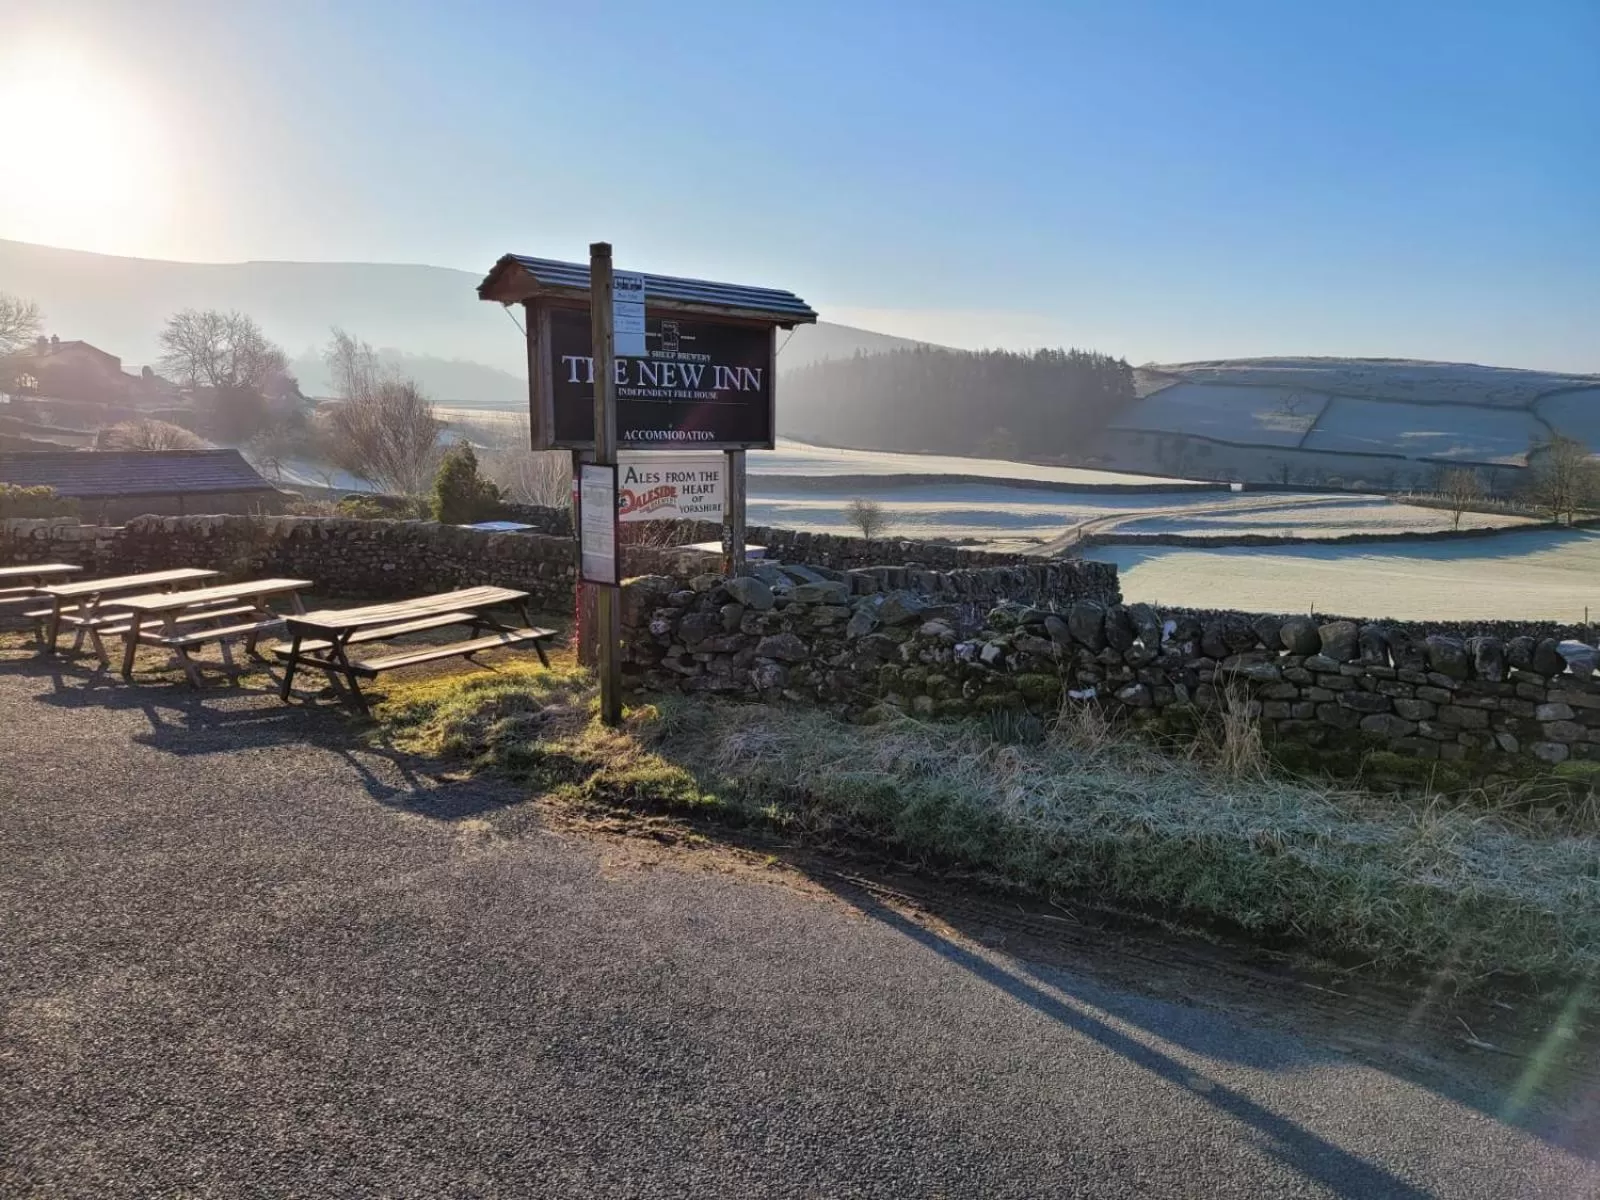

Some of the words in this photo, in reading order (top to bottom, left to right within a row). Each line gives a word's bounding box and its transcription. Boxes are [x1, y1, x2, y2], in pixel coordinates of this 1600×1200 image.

[637, 360, 705, 389] NEW
[713, 364, 763, 391] INN
[618, 387, 672, 397] INDEPENDENT
[674, 389, 693, 398] FREE
[694, 391, 718, 400] HOUSE
[624, 430, 715, 440] ACCOMMODATION
[665, 471, 695, 482] FROM
[698, 471, 719, 481] THE
[682, 483, 714, 494] HEART
[691, 495, 704, 503] OF
[679, 503, 722, 514] YORKSHIRE
